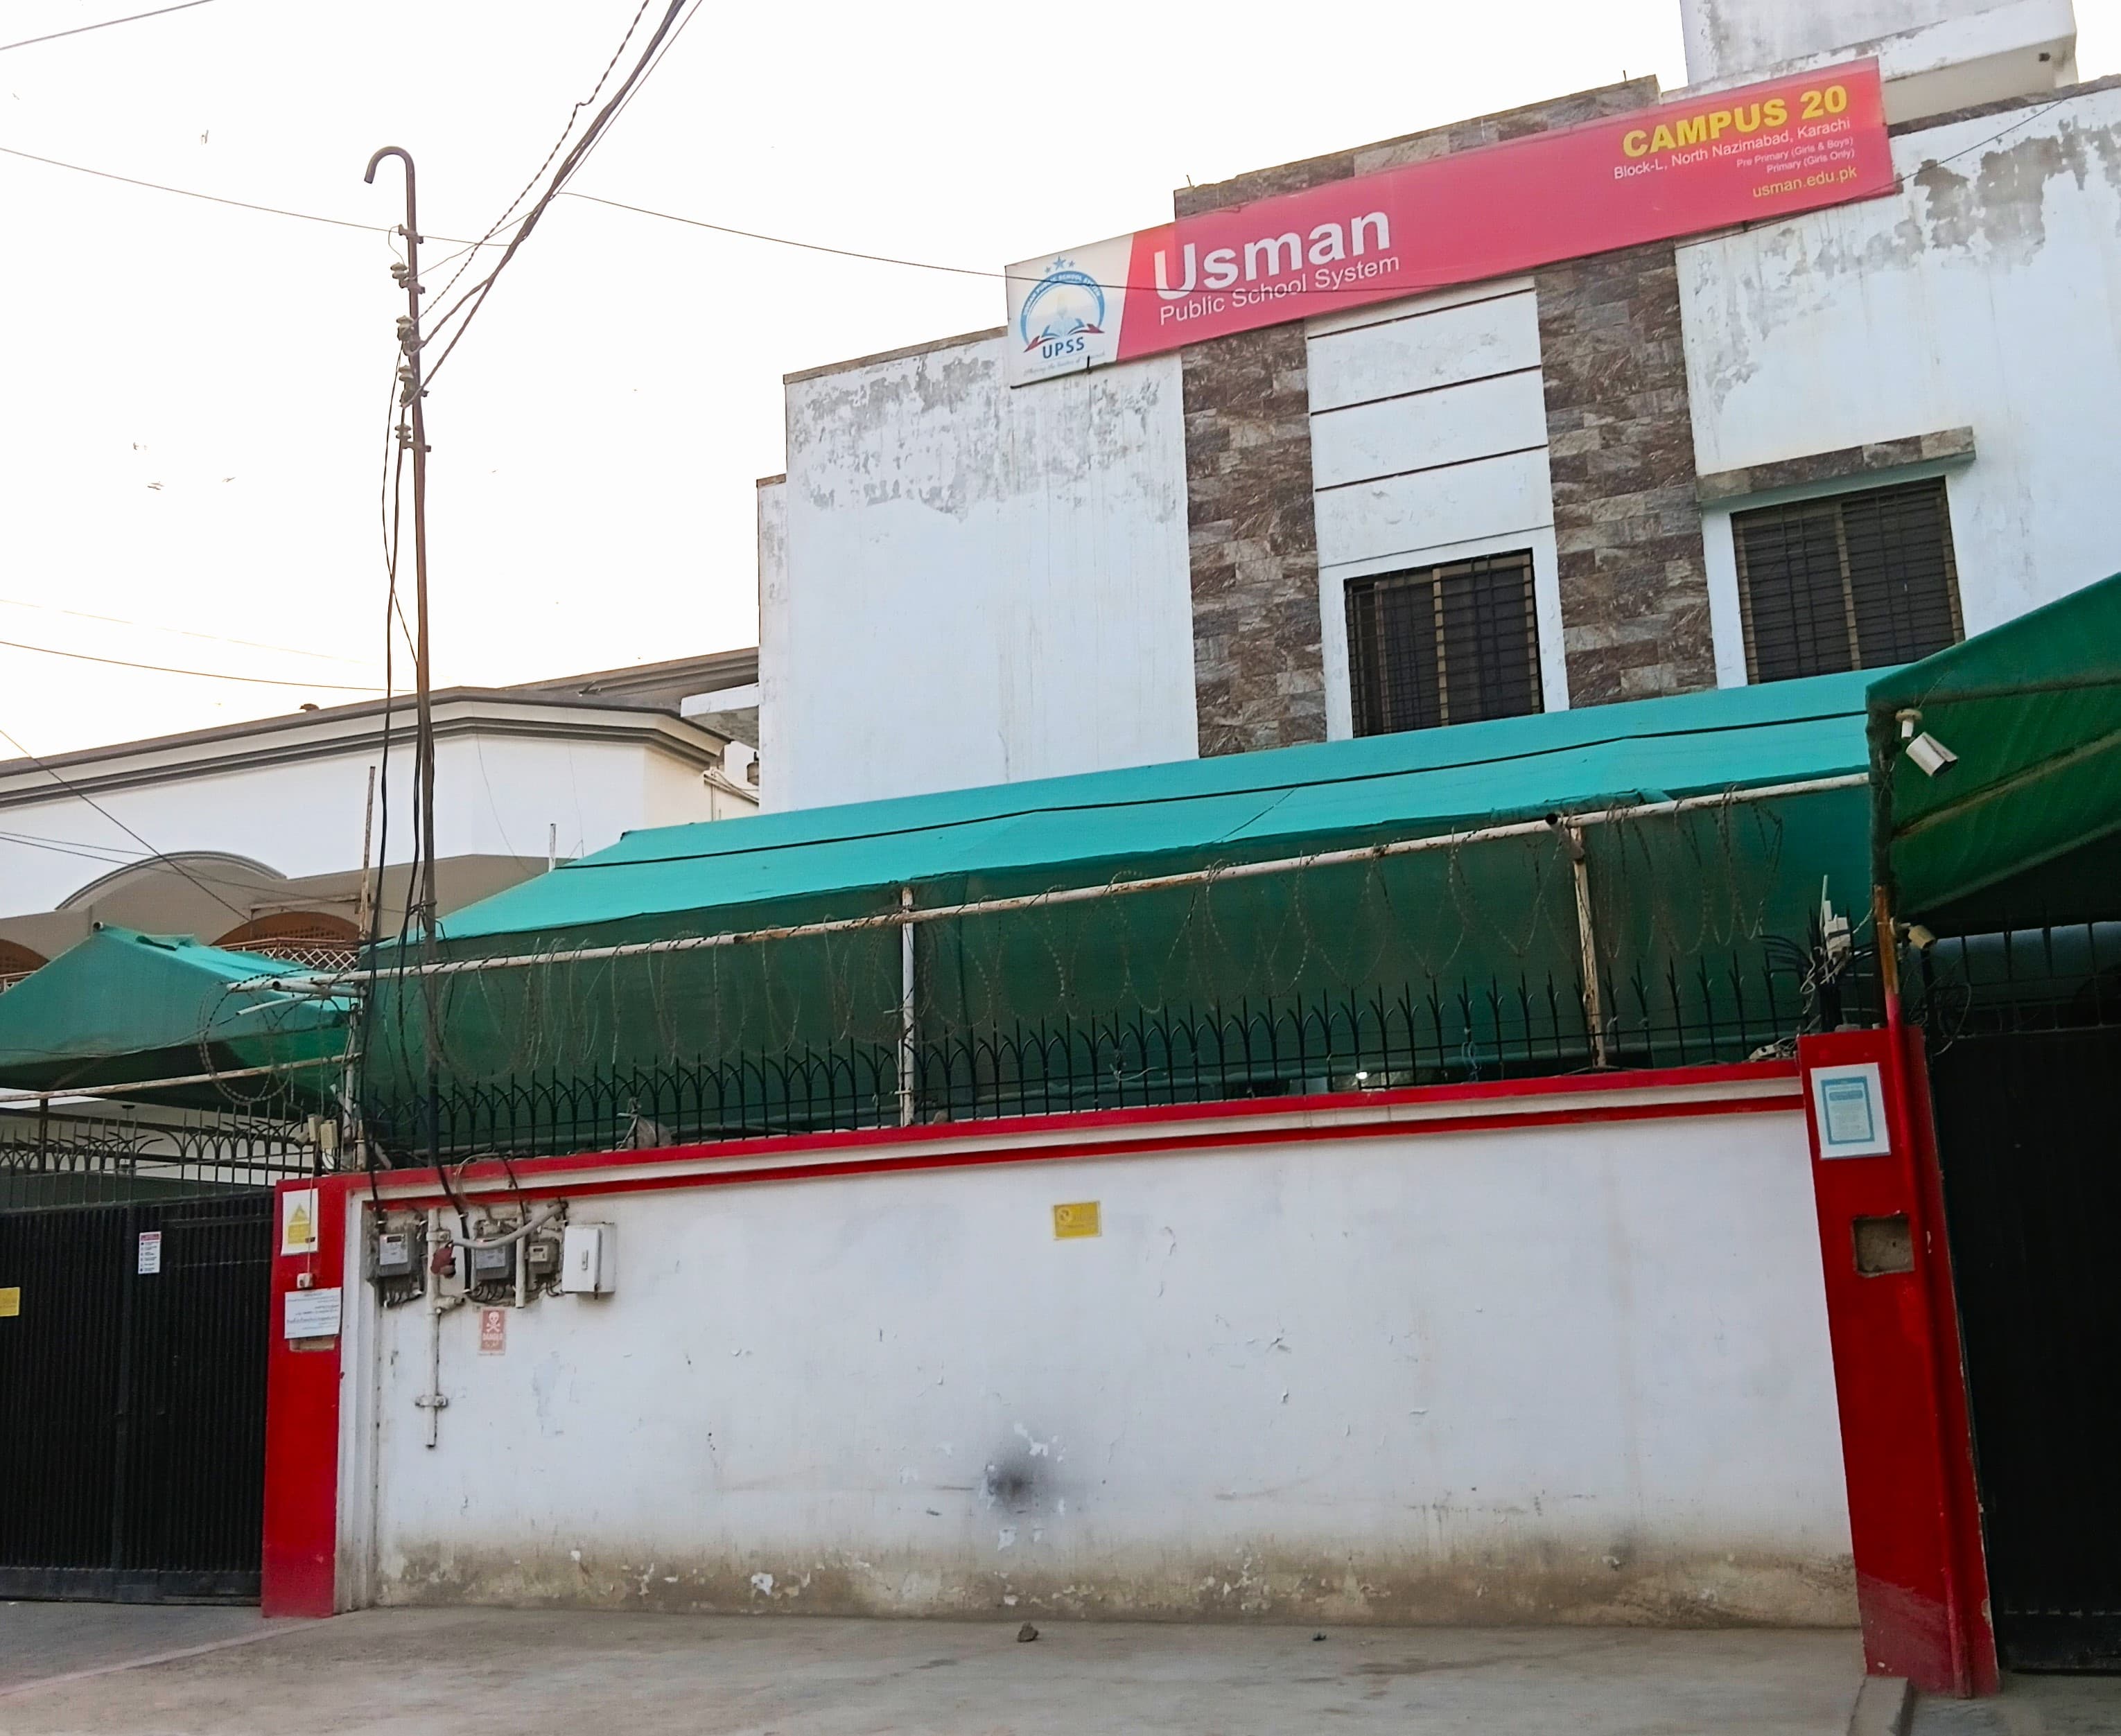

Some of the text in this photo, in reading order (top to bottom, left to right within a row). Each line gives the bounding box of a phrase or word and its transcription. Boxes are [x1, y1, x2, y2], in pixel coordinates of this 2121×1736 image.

[1623, 85, 1848, 157] CAMPUS 20
[1614, 116, 1851, 179] Block-L, North Nazimabad, Karachi
[1736, 137, 1853, 168] Pre Primary (Girls & Boys)
[1767, 148, 1855, 173] Primary (Girls Only)
[1752, 165, 1858, 198] usman.edu.pk
[1153, 211, 1390, 301] Usman
[1160, 256, 1400, 326] Public School System
[1042, 337, 1085, 359] UPSS
